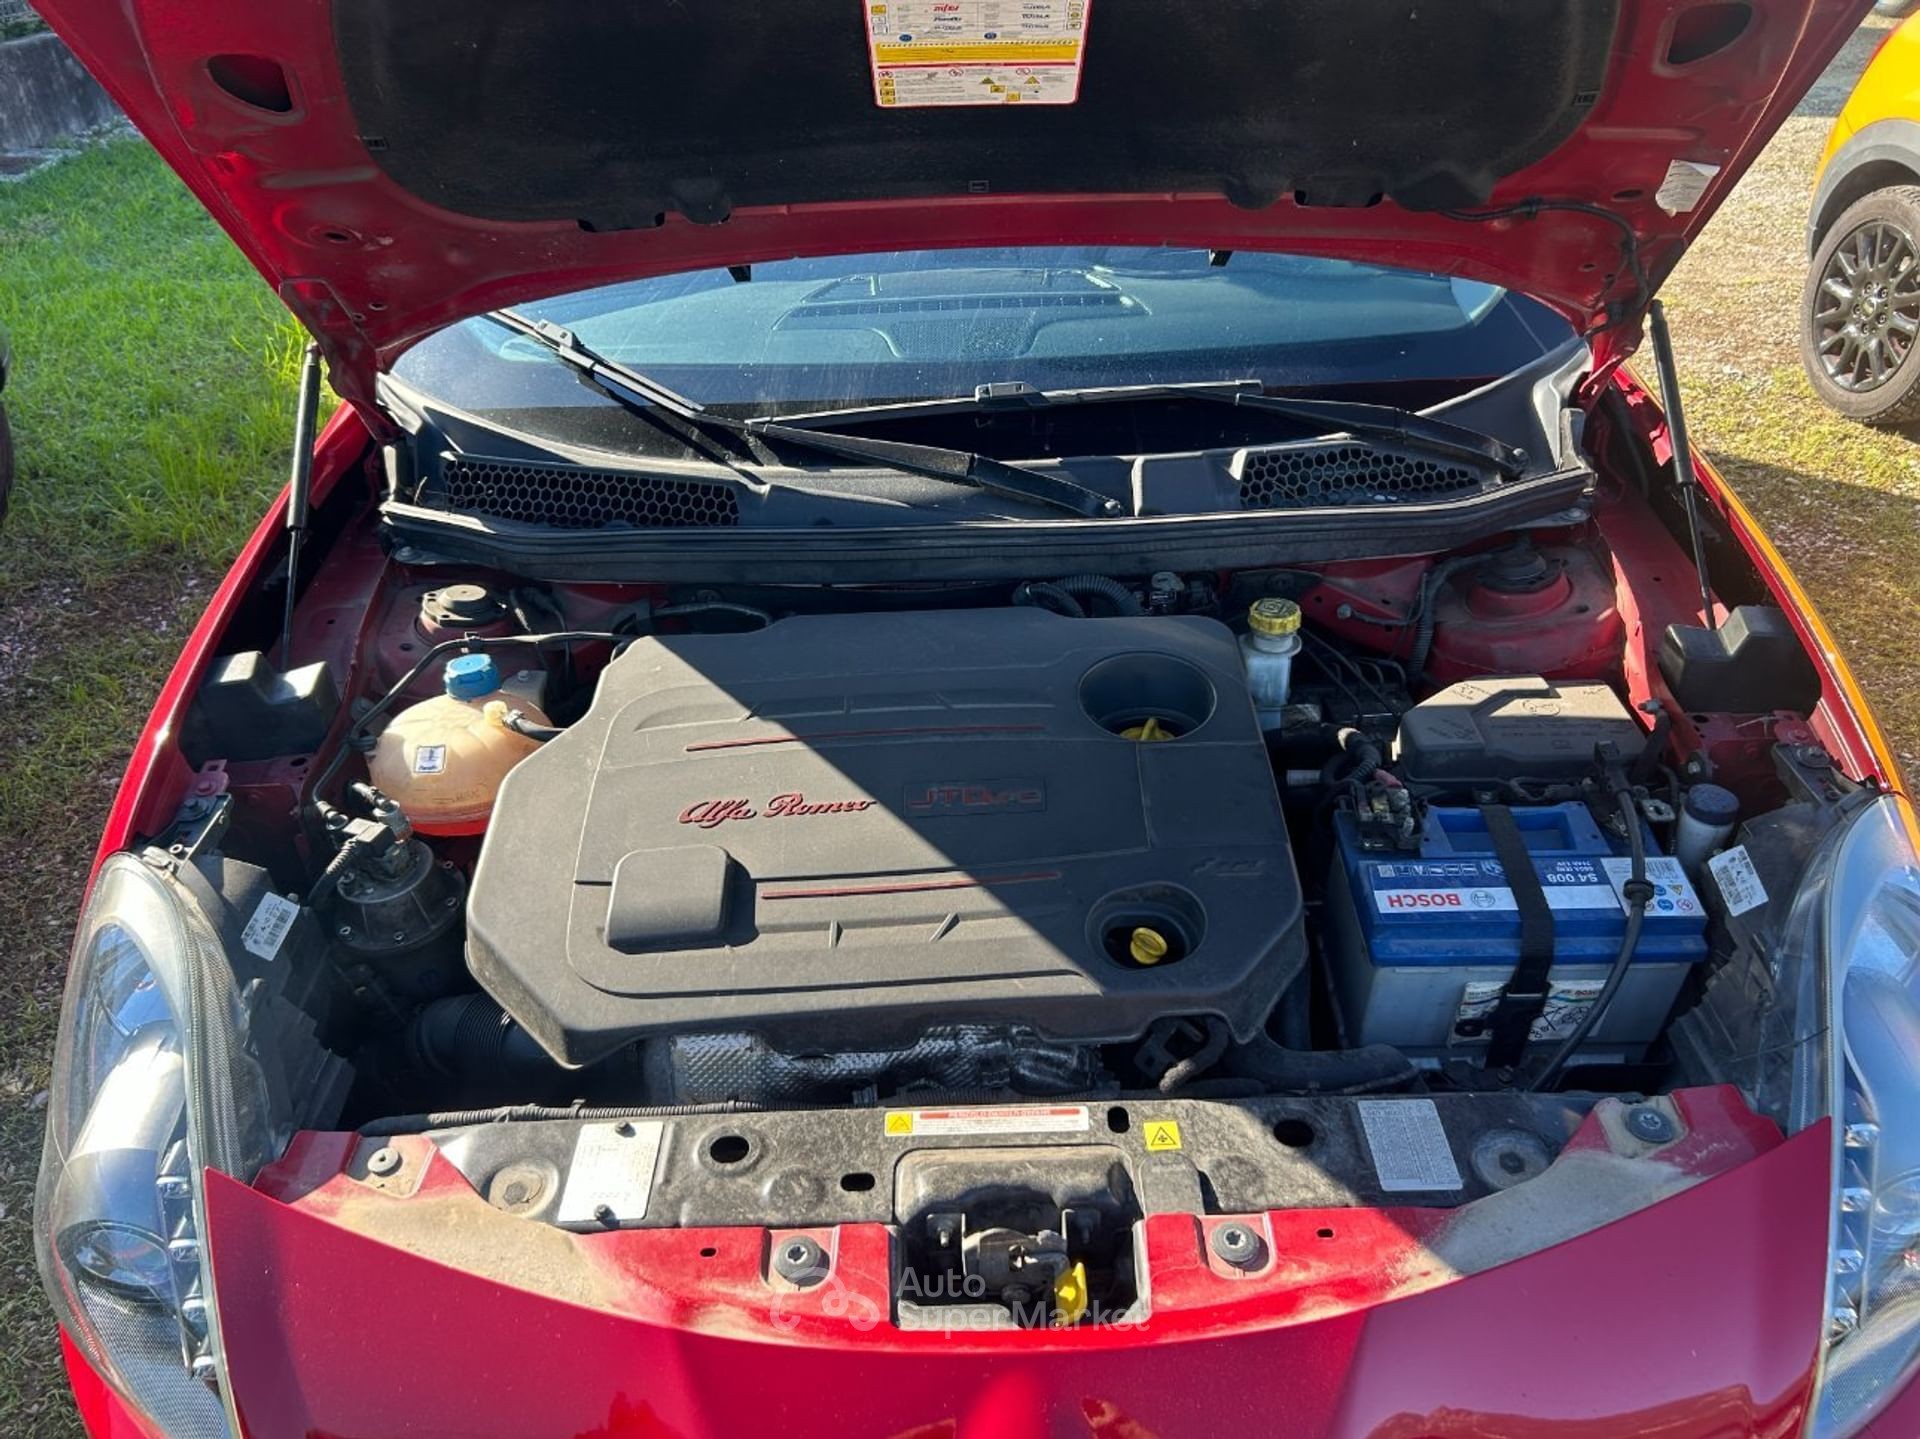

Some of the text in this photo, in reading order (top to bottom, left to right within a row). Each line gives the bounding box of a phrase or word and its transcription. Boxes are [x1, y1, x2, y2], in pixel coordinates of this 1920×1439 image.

[679, 793, 877, 829] Alfa Romeo
[1387, 893, 1463, 908] BOSCH
